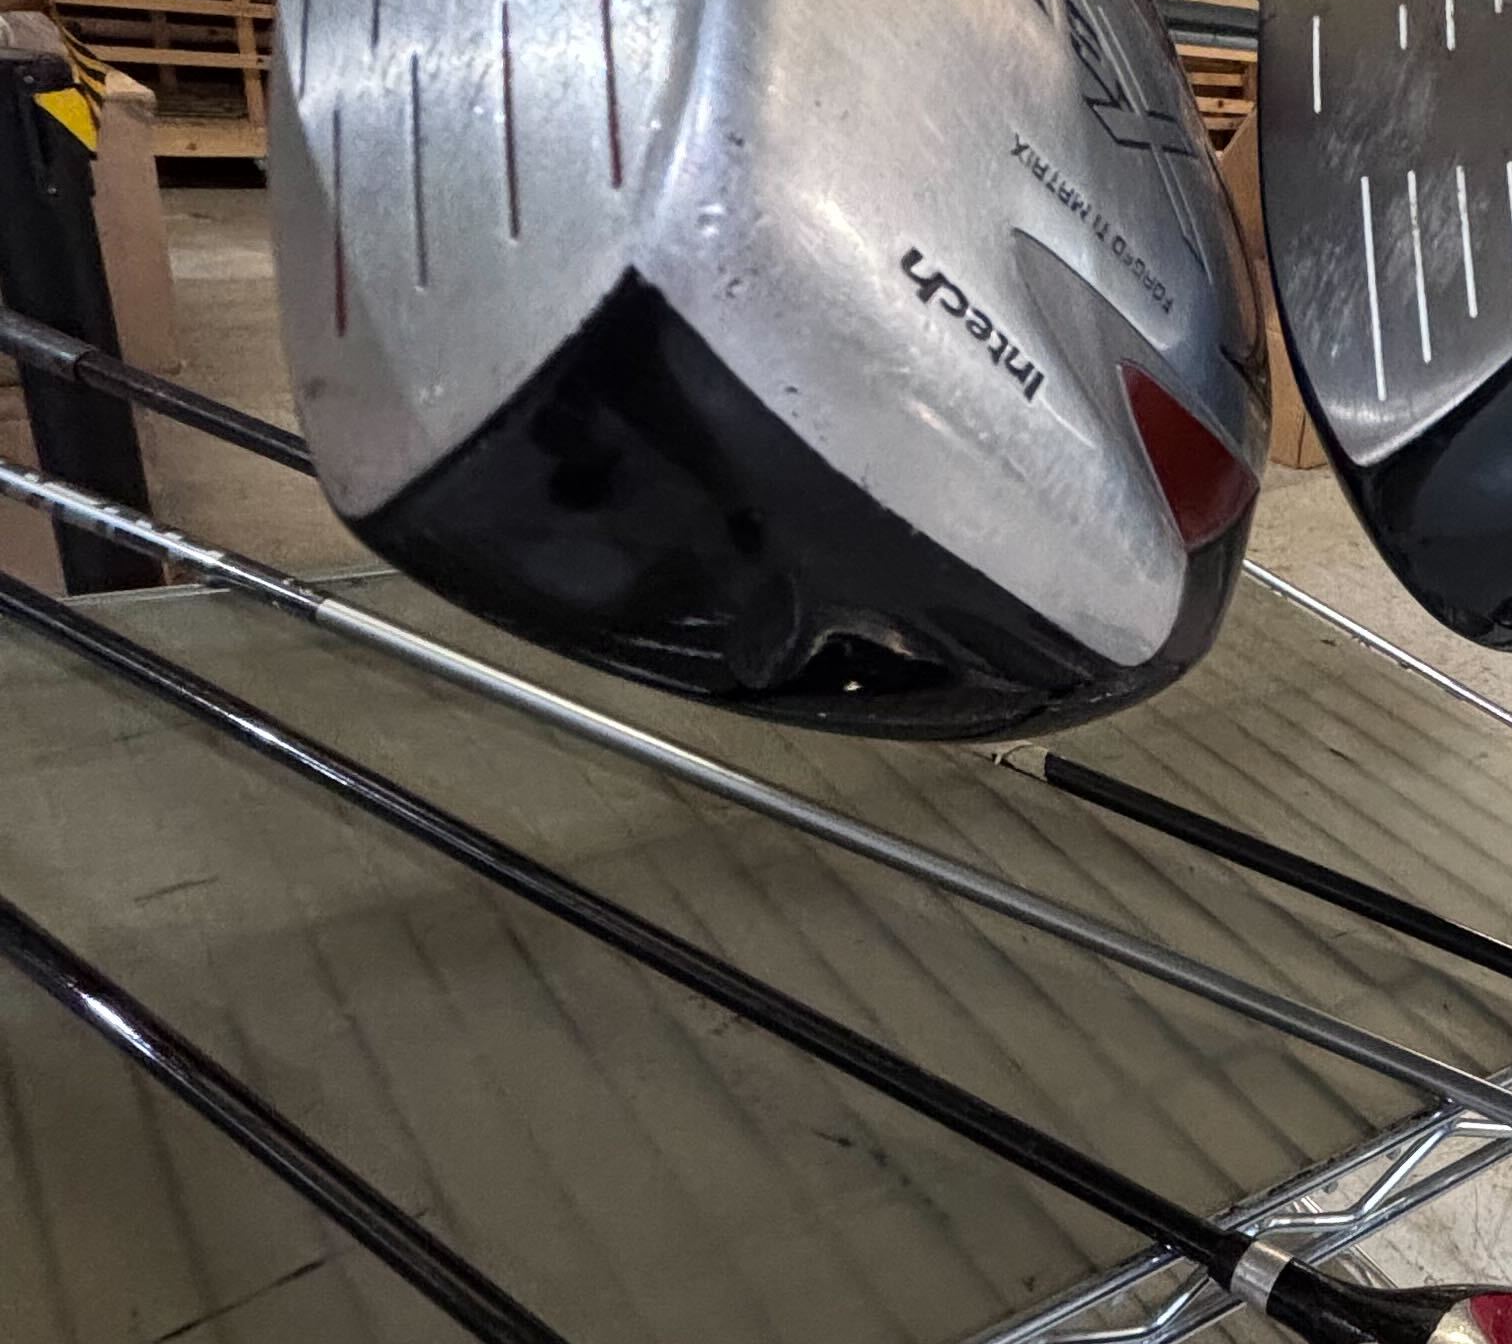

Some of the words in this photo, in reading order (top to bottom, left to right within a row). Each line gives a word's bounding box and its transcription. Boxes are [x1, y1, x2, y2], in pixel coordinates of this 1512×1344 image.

[1008, 132, 1092, 220] MATRIX
[1111, 234, 1175, 315] FORGED
[899, 248, 1046, 402] Intech
